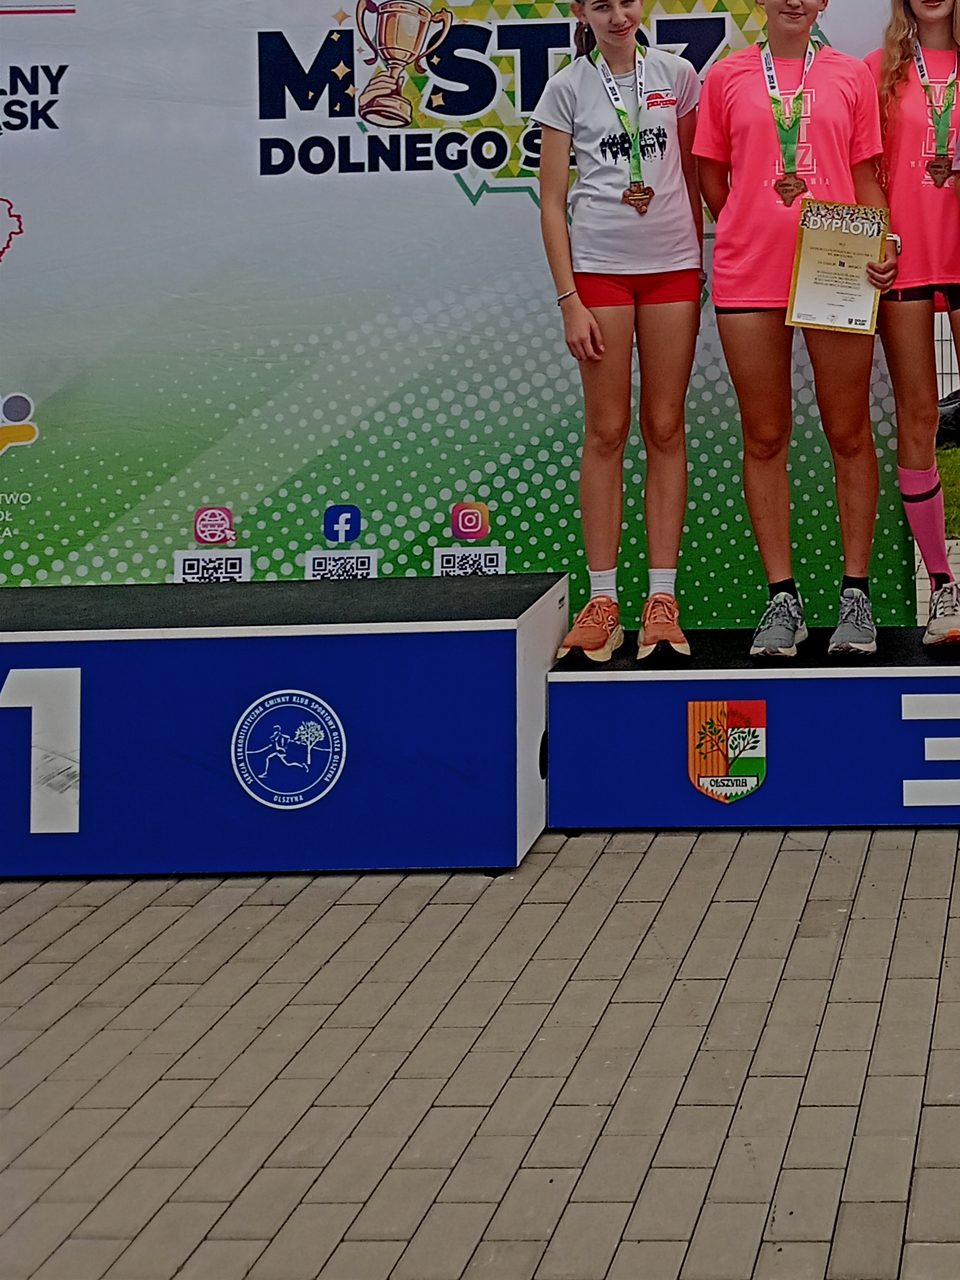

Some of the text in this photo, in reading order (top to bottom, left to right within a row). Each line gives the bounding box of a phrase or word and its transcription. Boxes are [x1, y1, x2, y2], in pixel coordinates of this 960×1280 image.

[0, 99, 60, 136] SK
[258, 130, 508, 176] DOLNEGO
[809, 217, 879, 237] DYPLOM
[292, 695, 309, 705] KLUB
[310, 701, 336, 730] SPORTOWY
[0, 667, 81, 833] 1
[273, 794, 304, 804] OLSZYNA
